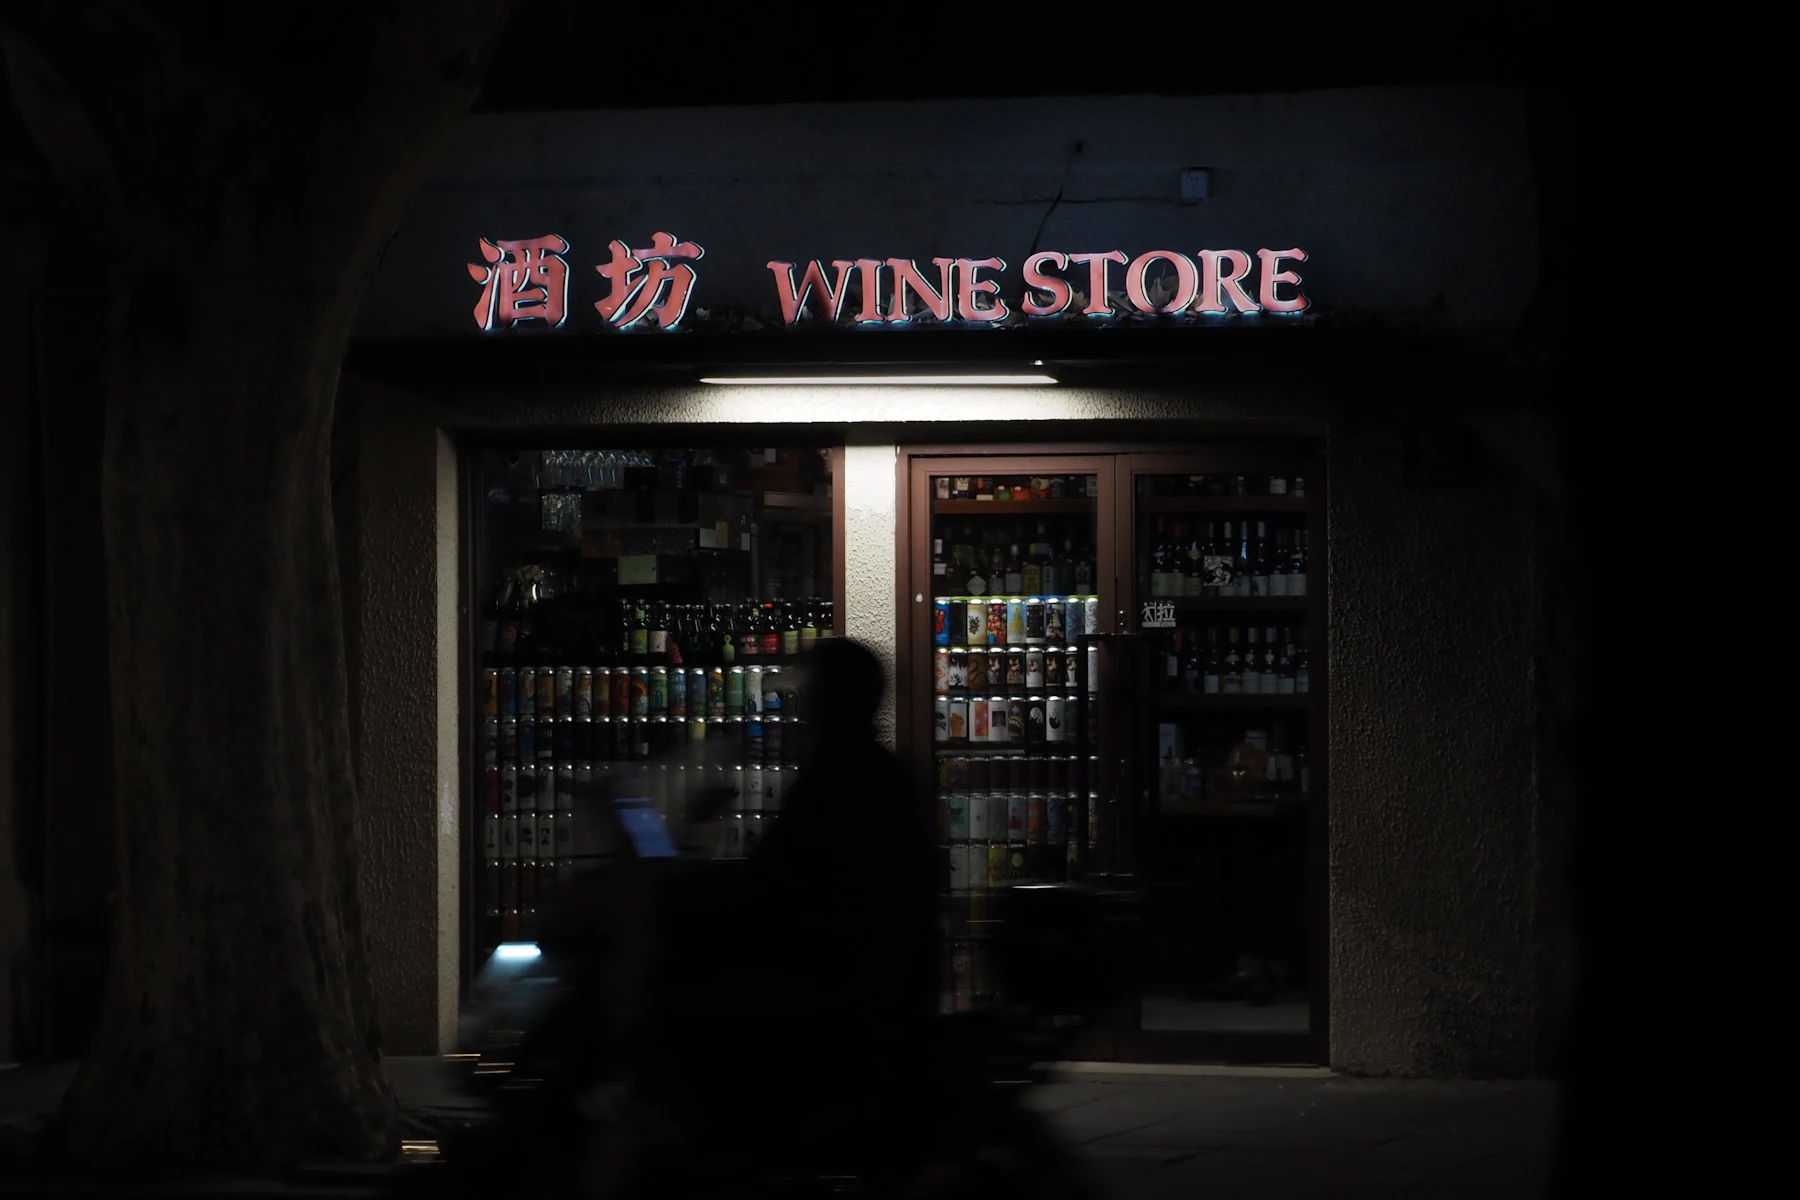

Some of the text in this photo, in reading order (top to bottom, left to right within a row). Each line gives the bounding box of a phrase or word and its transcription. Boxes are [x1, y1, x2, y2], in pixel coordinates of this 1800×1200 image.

[466, 231, 704, 330] 酒坊
[766, 247, 1311, 324] WINE STORE
[1156, 602, 1176, 622] 拉
